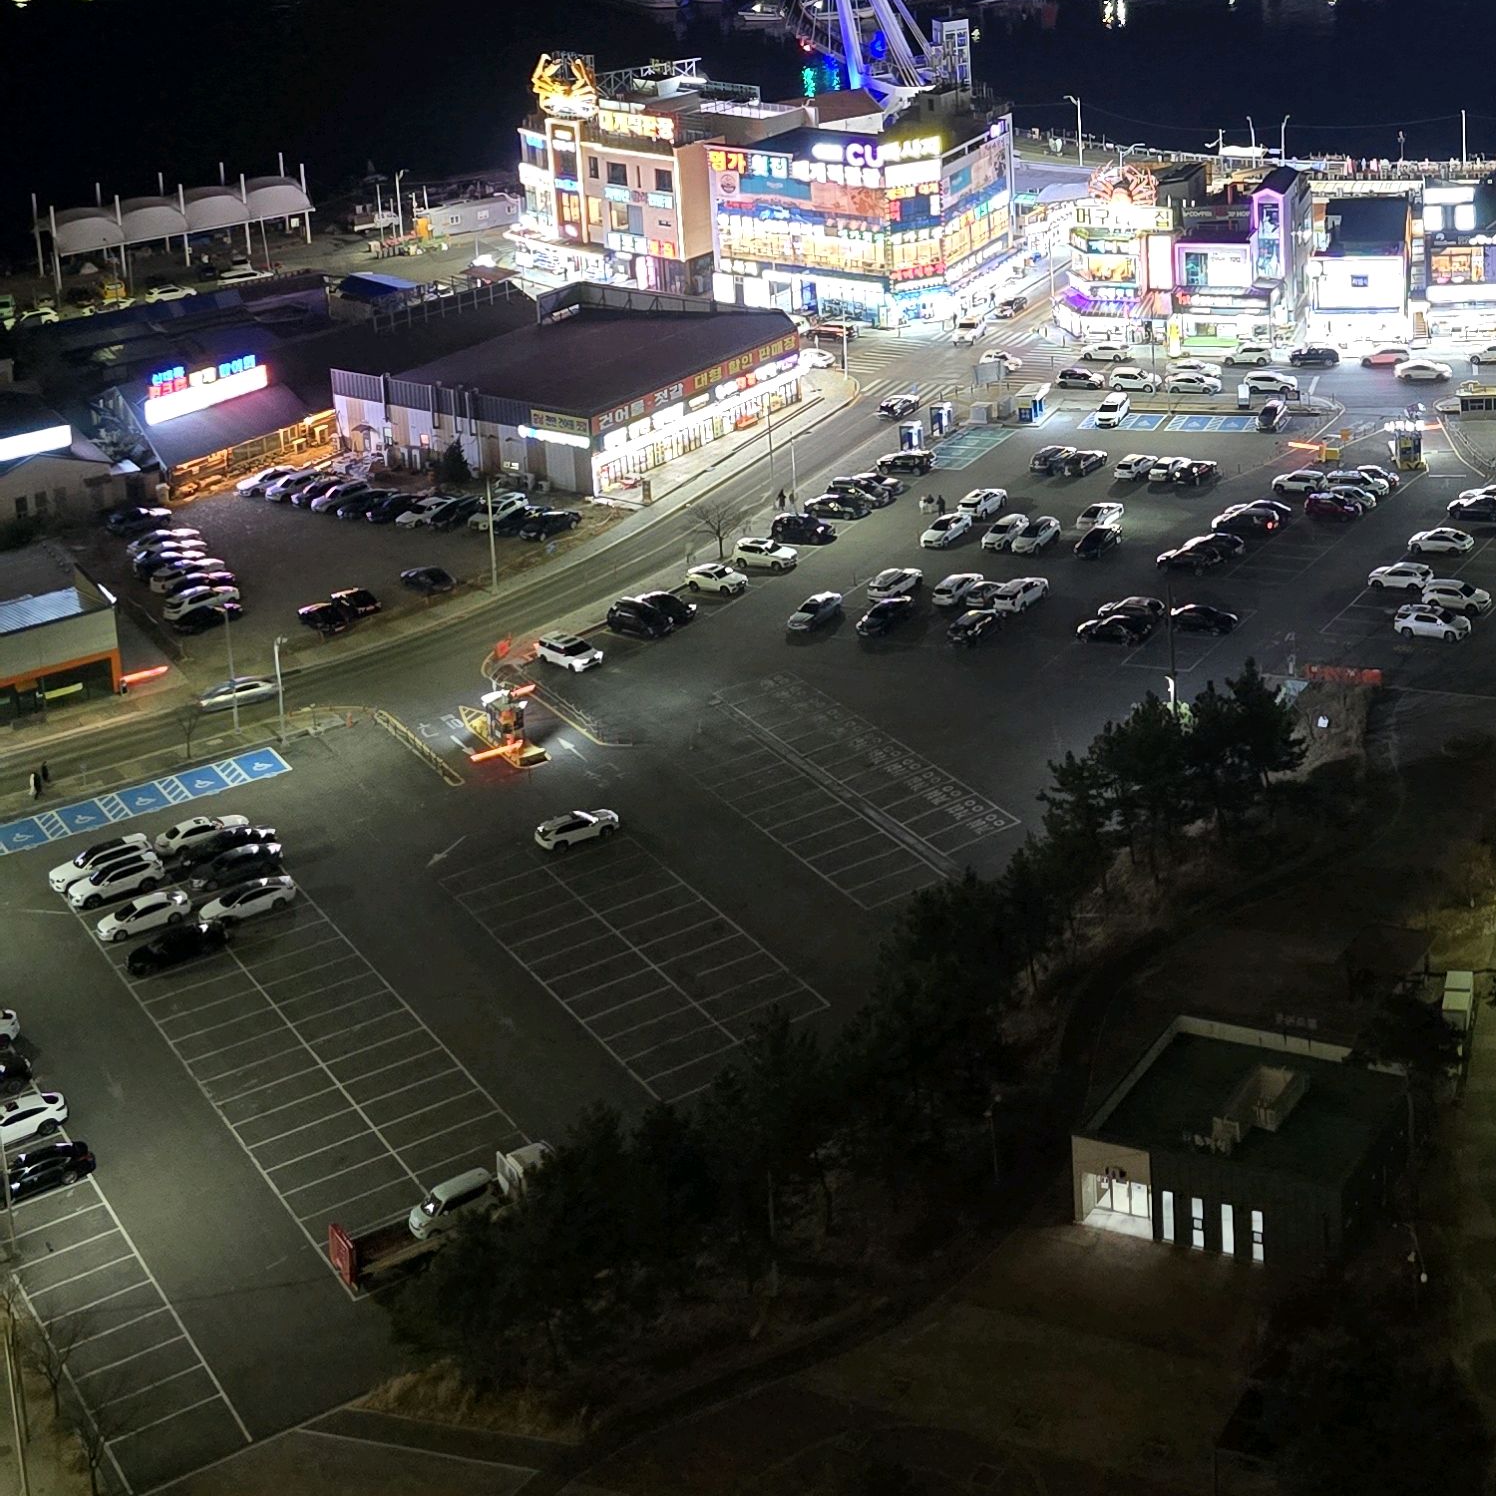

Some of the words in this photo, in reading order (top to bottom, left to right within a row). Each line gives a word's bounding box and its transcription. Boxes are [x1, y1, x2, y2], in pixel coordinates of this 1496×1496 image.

[710, 151, 746, 174] 명가
[846, 143, 884, 168] CU
[599, 400, 645, 430] 건어물
[654, 383, 684, 403] 젓갈
[694, 367, 722, 389] 대형
[727, 353, 753, 374] 할인
[759, 336, 796, 361] 판매장
